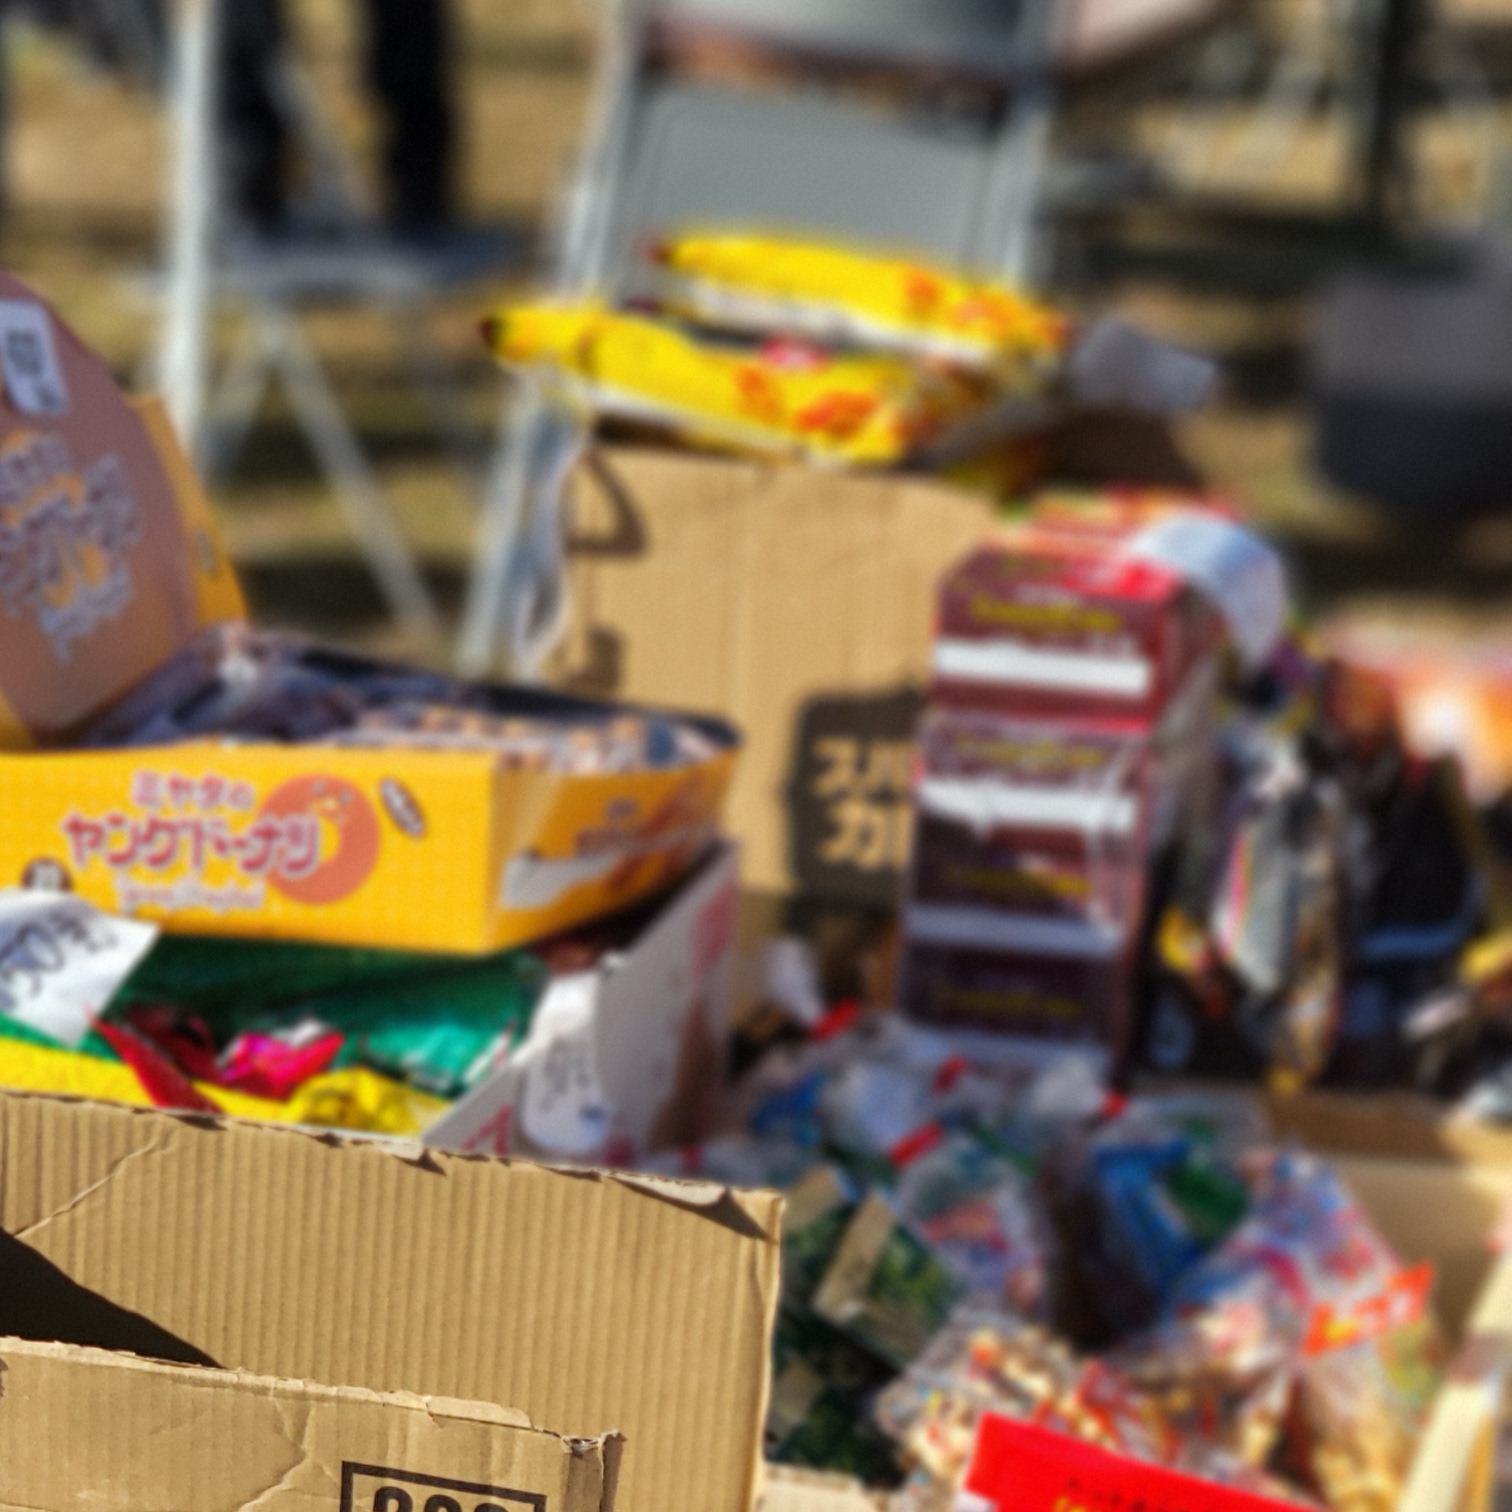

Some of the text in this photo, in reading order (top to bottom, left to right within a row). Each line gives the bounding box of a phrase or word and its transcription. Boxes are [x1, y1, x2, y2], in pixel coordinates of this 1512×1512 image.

[132, 769, 256, 811] ミヤタの
[64, 811, 321, 878] ヤングドーナツ
